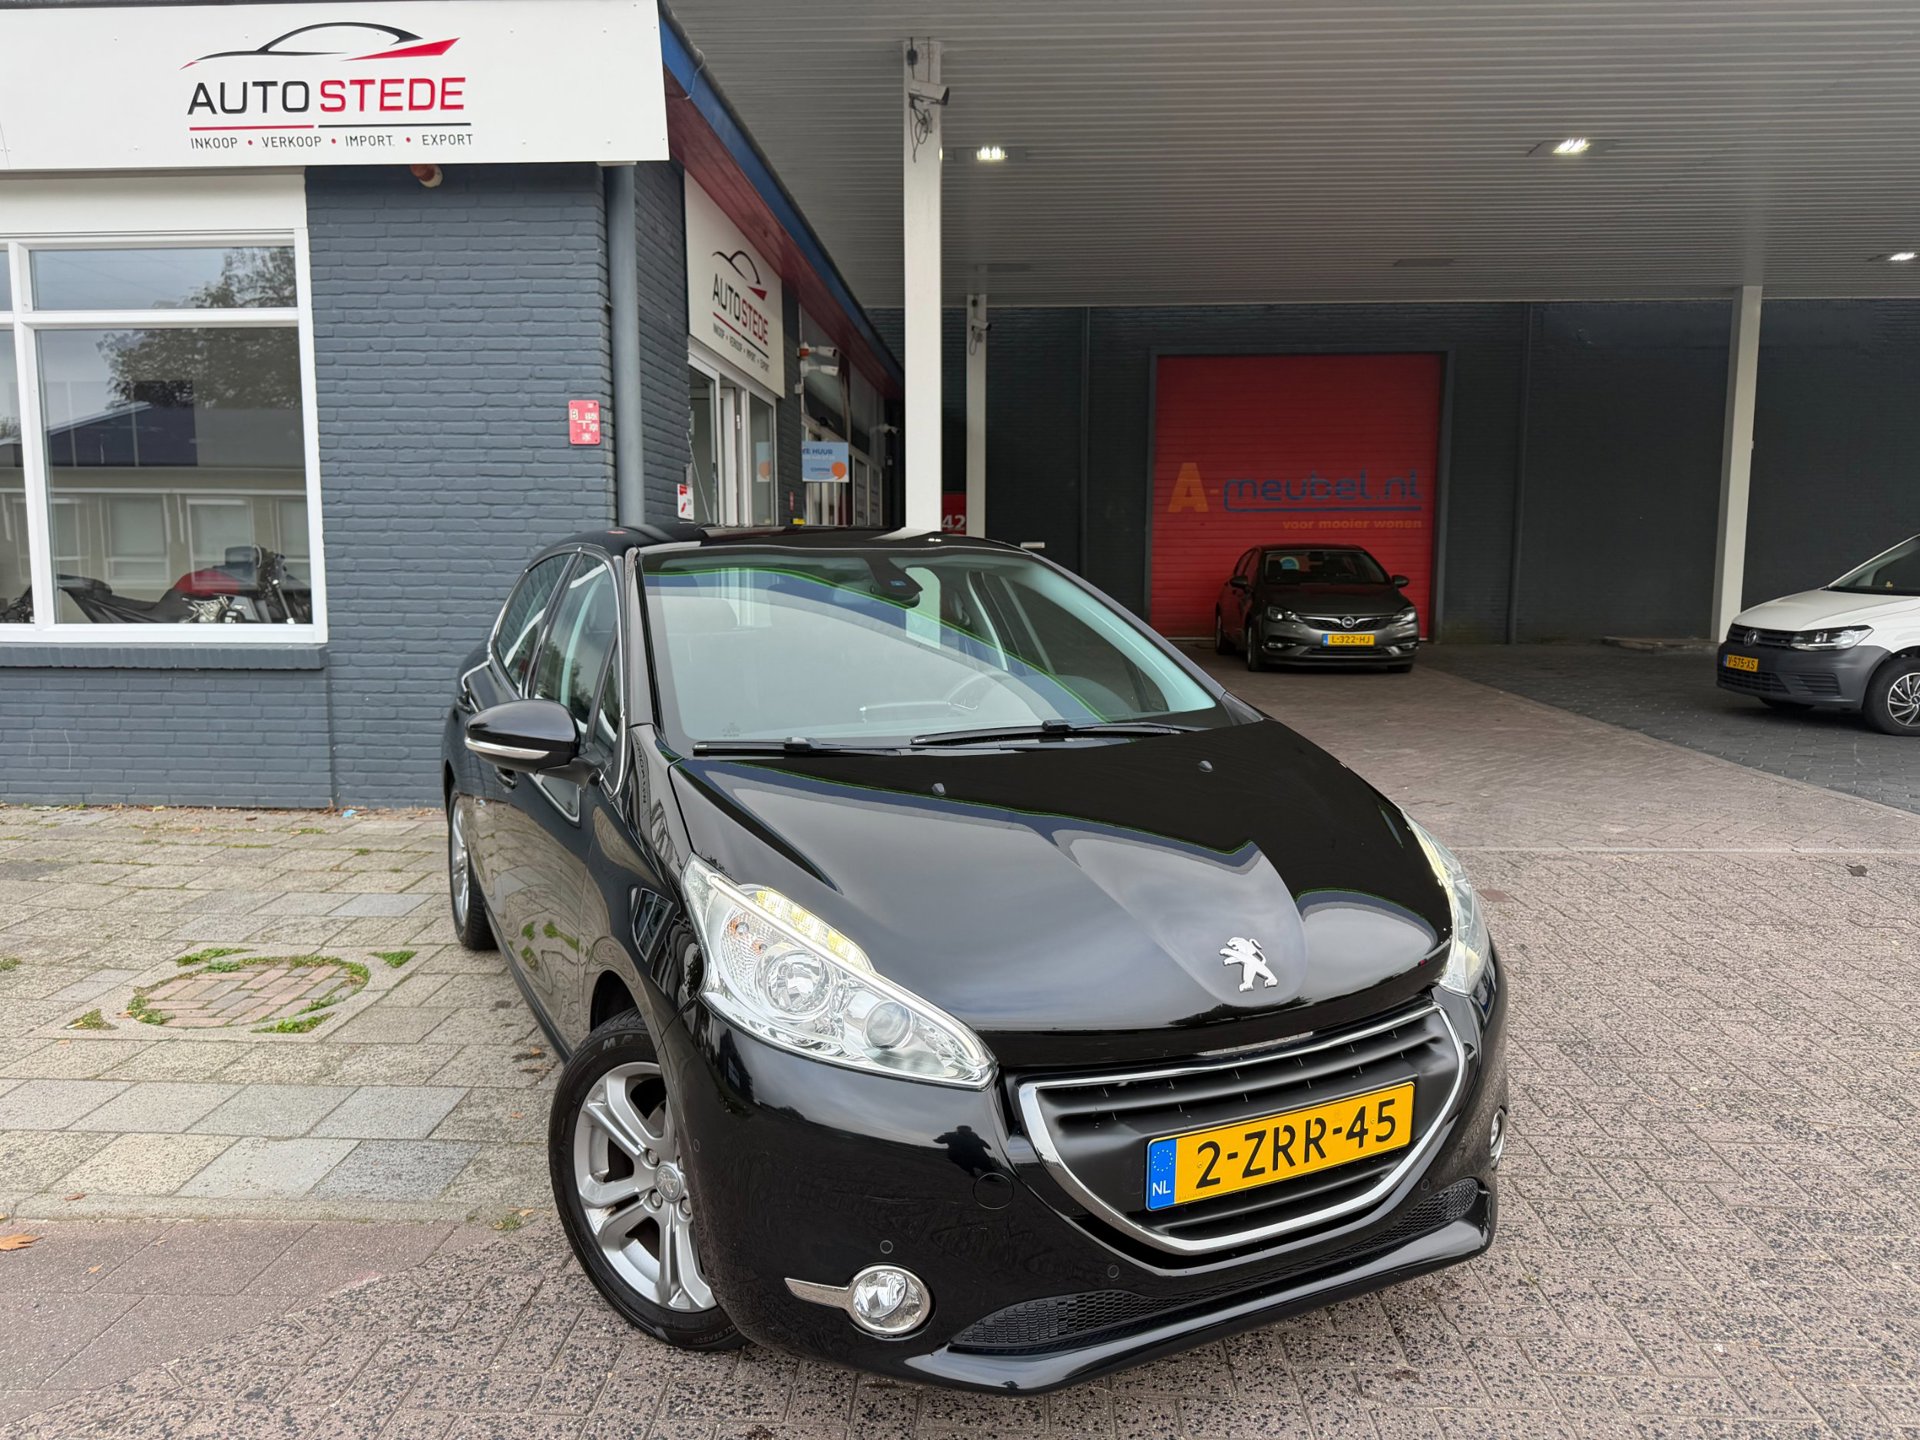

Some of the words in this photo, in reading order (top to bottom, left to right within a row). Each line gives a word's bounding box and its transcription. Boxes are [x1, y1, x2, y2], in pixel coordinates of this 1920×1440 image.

[190, 137, 238, 149] INKOOP
[262, 136, 322, 148] VERKOOP
[345, 135, 393, 147] IMPORT
[422, 133, 473, 146] EXPORT
[1282, 519, 1314, 530] voor
[1318, 518, 1370, 530] mooier
[1373, 518, 1423, 529] wonen
[1152, 1180, 1172, 1197] NL
[1195, 1098, 1396, 1190] 2-ZRR-45
